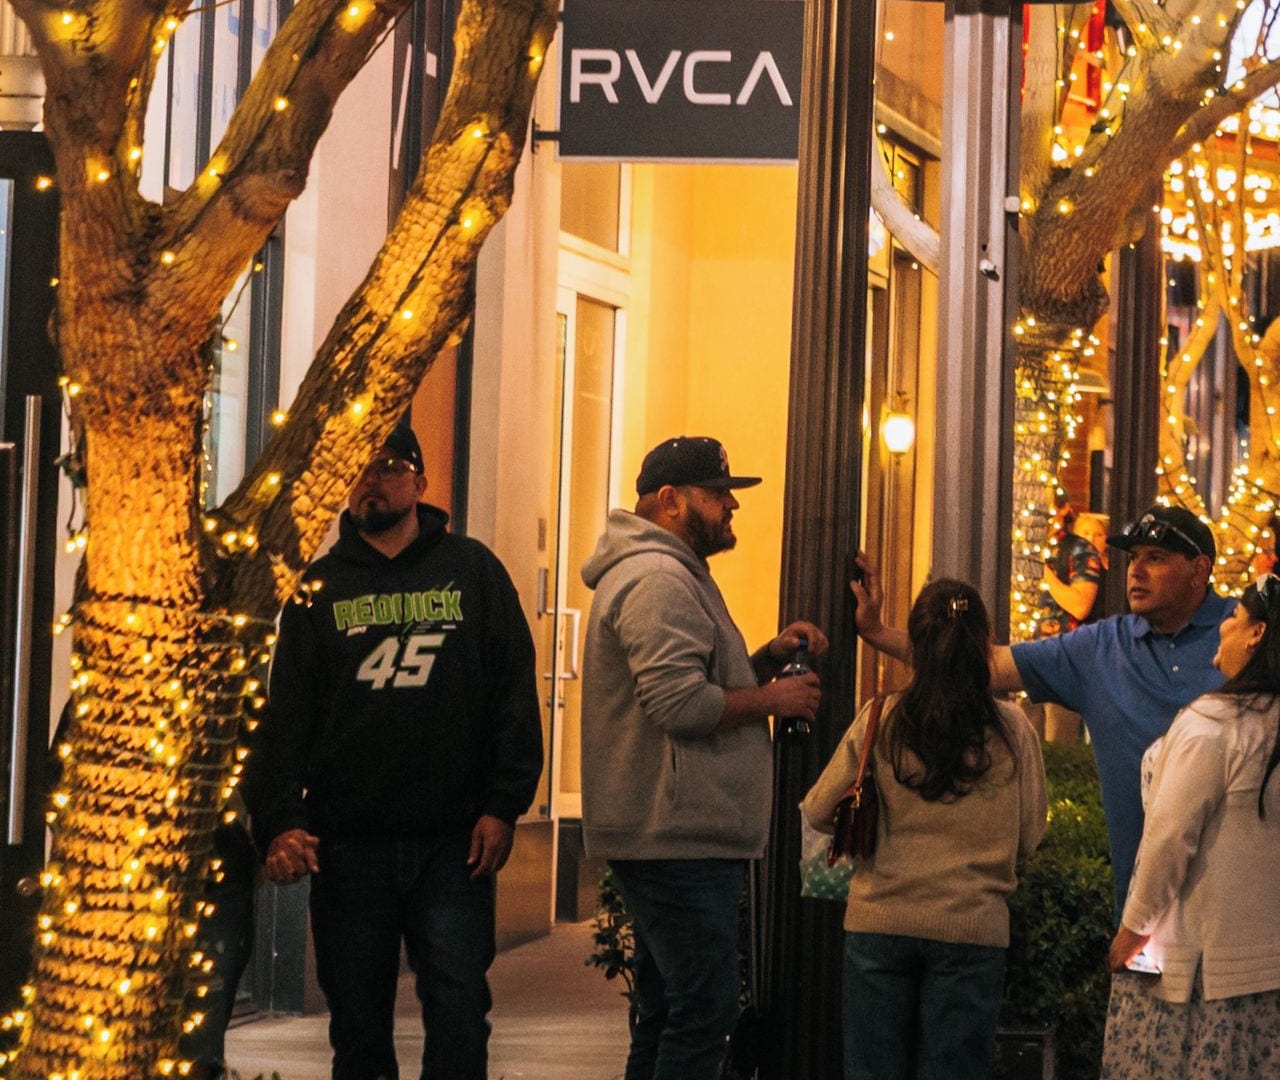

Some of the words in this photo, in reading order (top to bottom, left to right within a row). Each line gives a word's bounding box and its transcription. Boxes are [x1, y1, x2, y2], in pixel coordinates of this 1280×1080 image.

[570, 48, 794, 107] RVCA
[332, 587, 464, 631] REDDICK
[356, 633, 446, 690] 45
